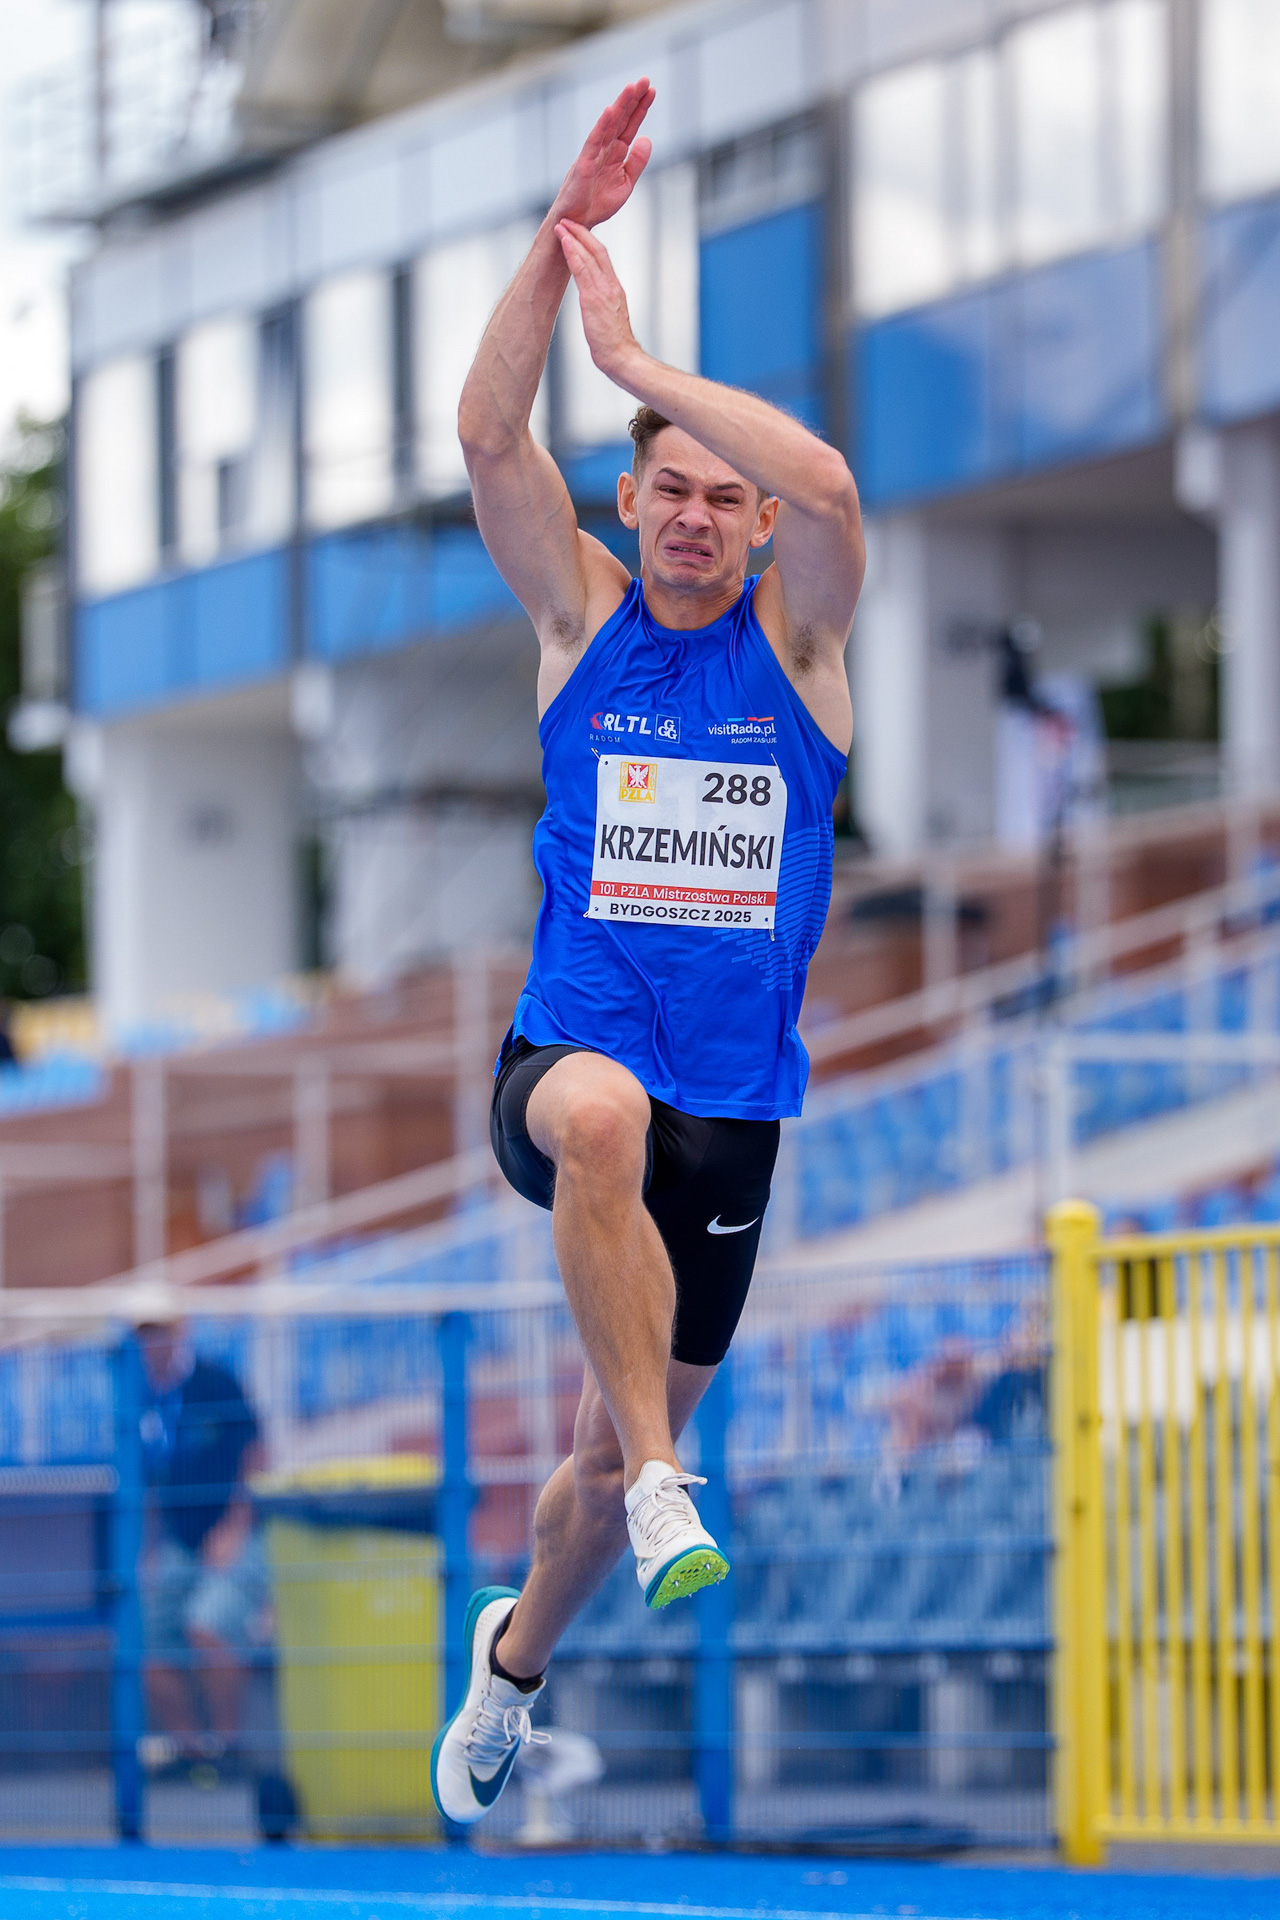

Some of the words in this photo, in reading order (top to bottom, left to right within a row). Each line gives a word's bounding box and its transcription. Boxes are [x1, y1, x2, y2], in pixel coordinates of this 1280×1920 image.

[589, 733, 621, 743] RADOM
[620, 789, 653, 802] PZLA
[701, 772, 772, 806] 288
[600, 823, 775, 870] KRZEMIŃSKI
[600, 883, 618, 896] 101.
[620, 886, 650, 899] PZLA
[653, 888, 730, 904] Mistrzostwa
[732, 893, 767, 905] Polski
[609, 903, 711, 922] BYDGOSZCZ
[713, 909, 752, 923] 2025
